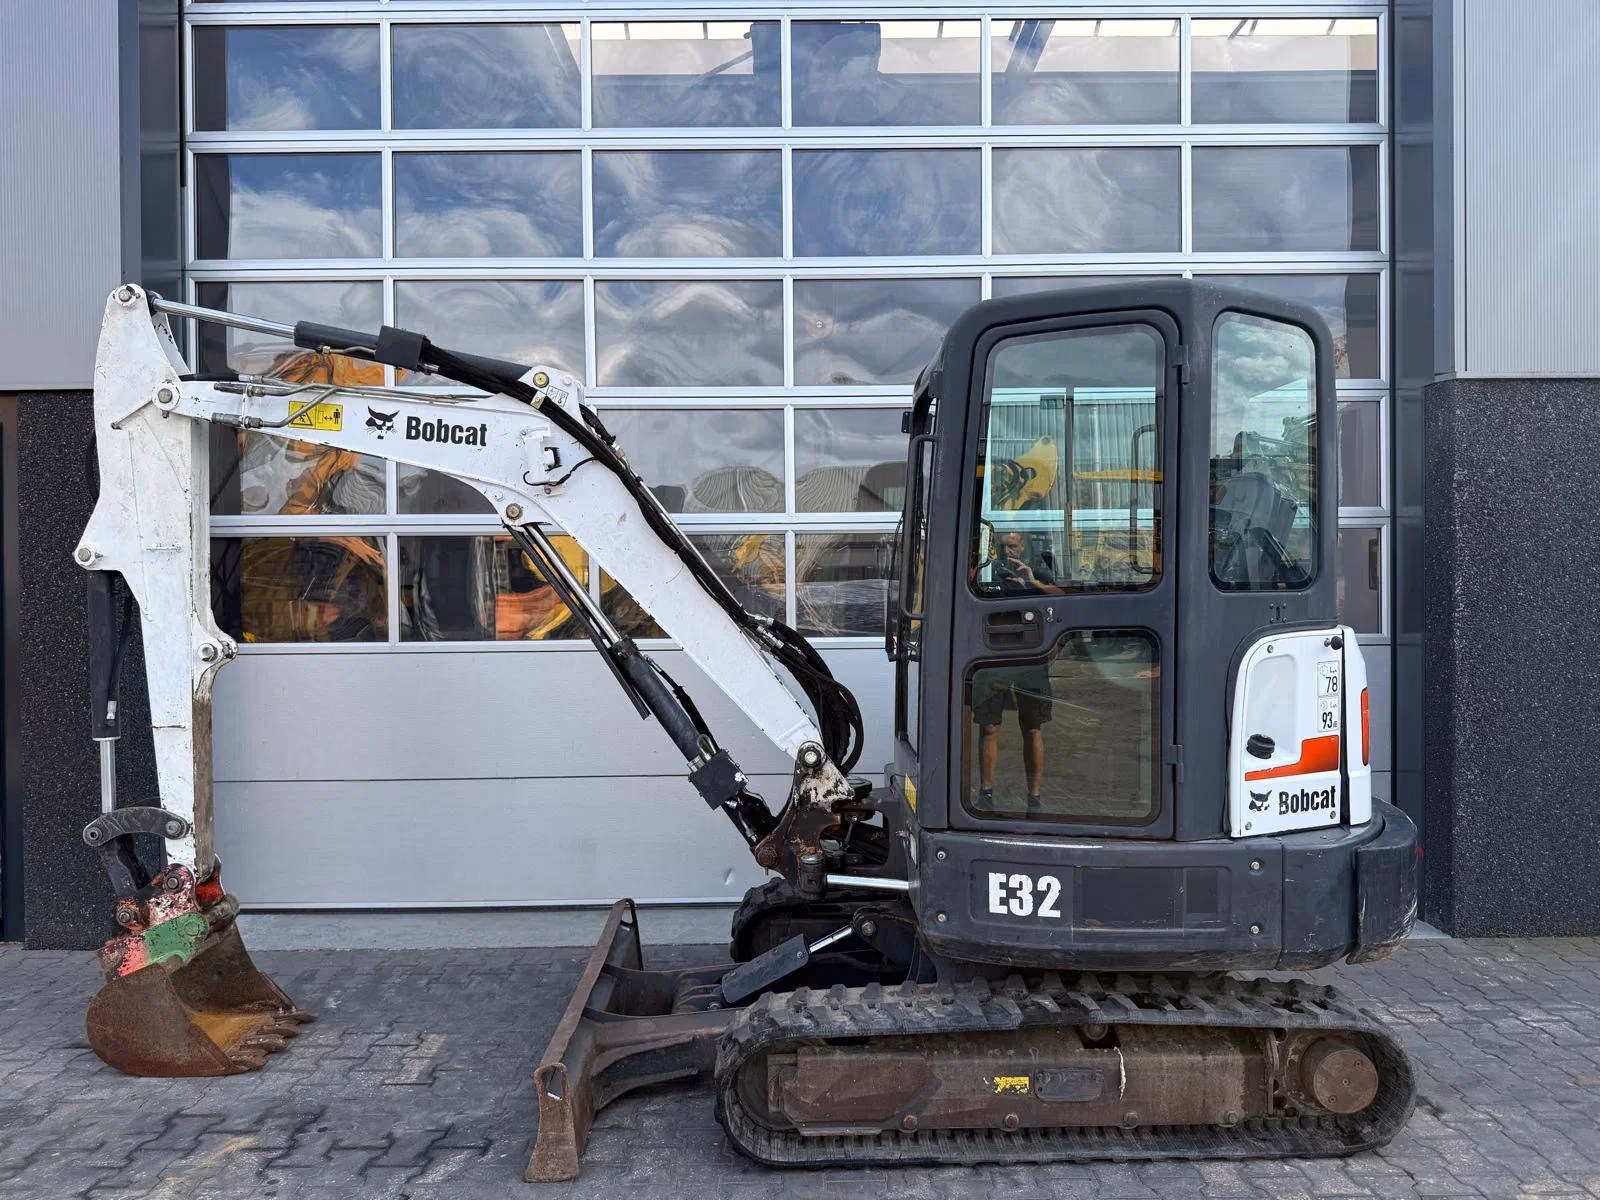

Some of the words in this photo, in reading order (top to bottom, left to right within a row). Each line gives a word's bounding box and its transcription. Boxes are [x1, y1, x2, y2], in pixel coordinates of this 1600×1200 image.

[405, 416, 488, 447] Bobcat
[1325, 676, 1338, 693] 78
[1322, 711, 1333, 729] 93
[1278, 785, 1336, 815] Bobcat
[988, 872, 1062, 918] E32
